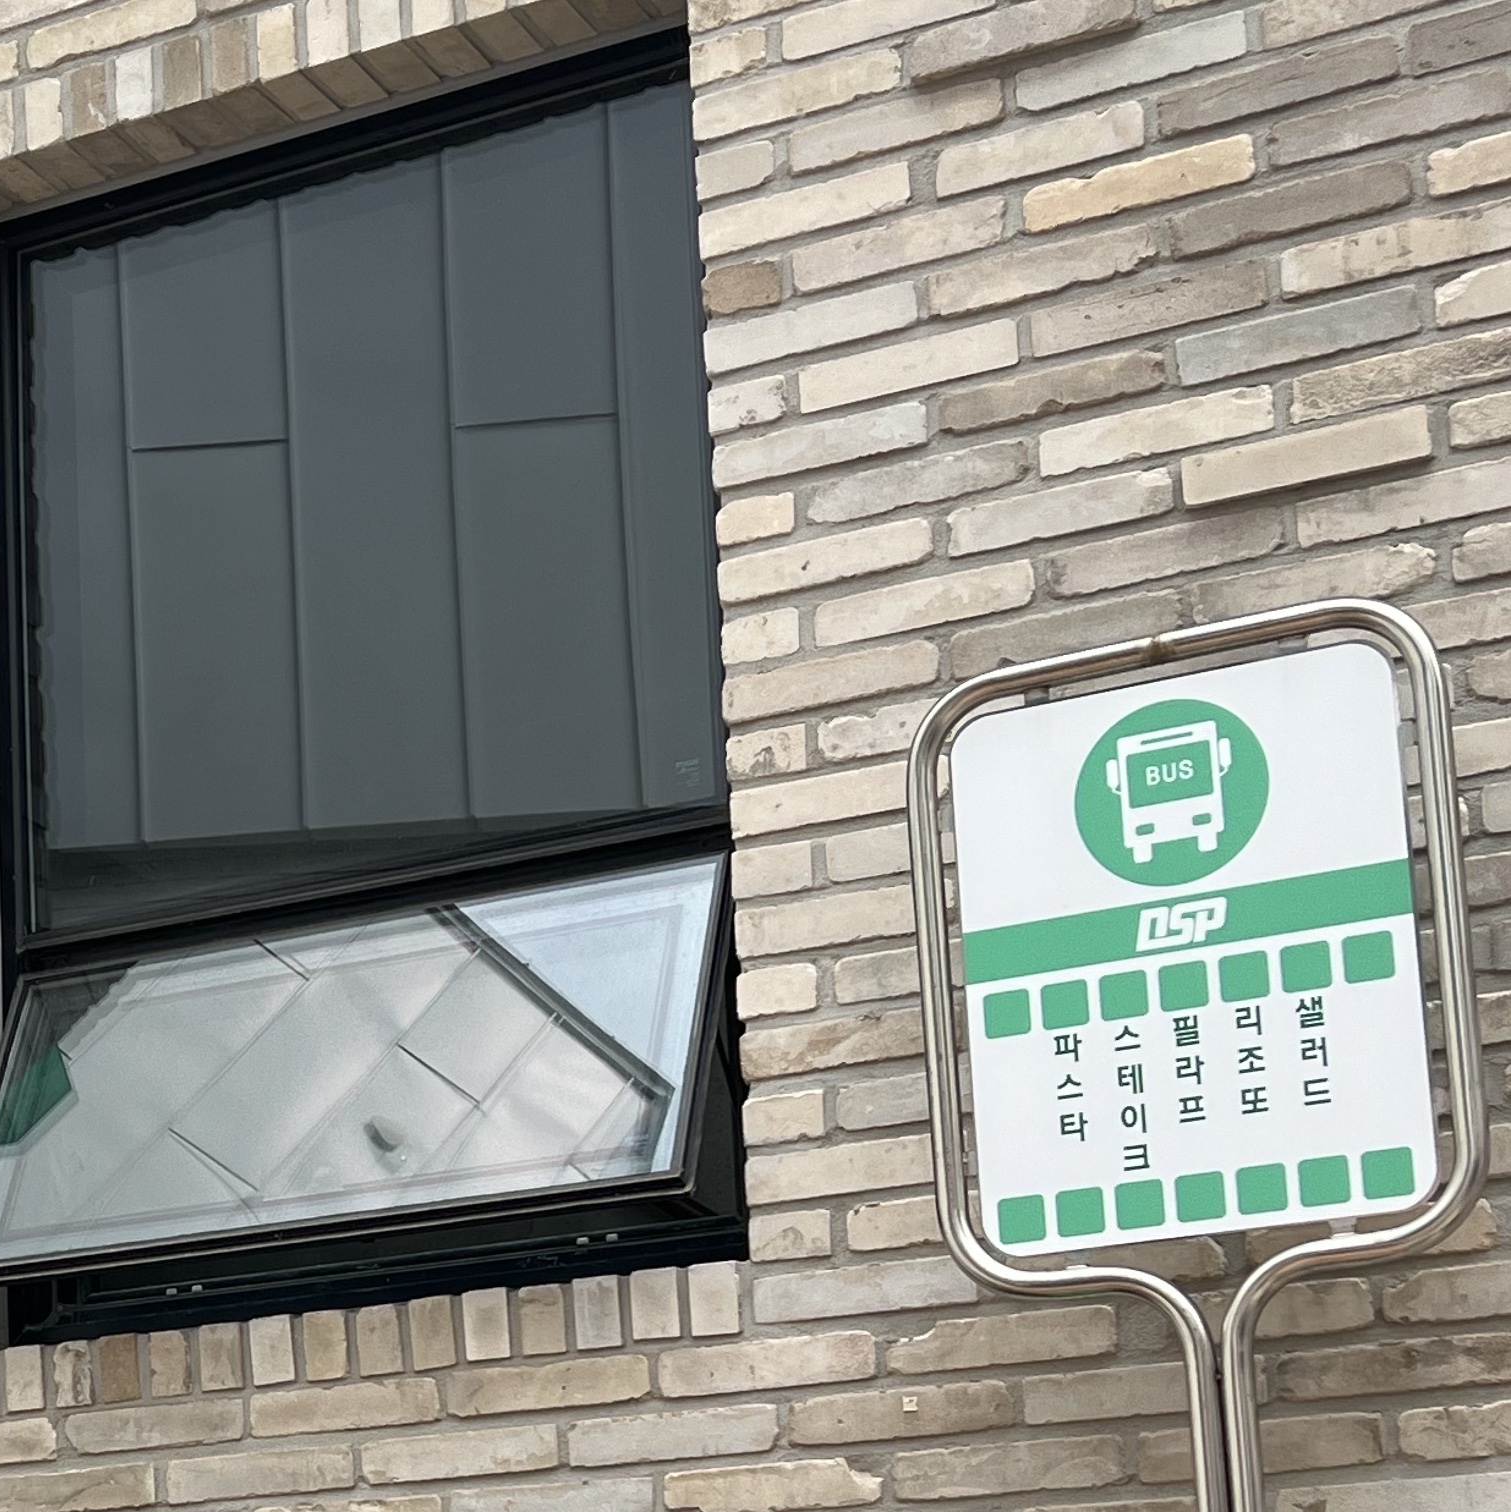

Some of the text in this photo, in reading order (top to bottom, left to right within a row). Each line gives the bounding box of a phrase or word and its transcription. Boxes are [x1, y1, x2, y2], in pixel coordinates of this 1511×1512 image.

[1145, 759, 1194, 786] BUS
[1136, 897, 1227, 952] DSP
[1054, 1033, 1088, 1141] 파스타
[1114, 1025, 1150, 1171] 스테이크
[1173, 1015, 1206, 1123] 필라프
[1235, 1005, 1269, 1114] 리조또
[1296, 996, 1331, 1106] 샐러드
